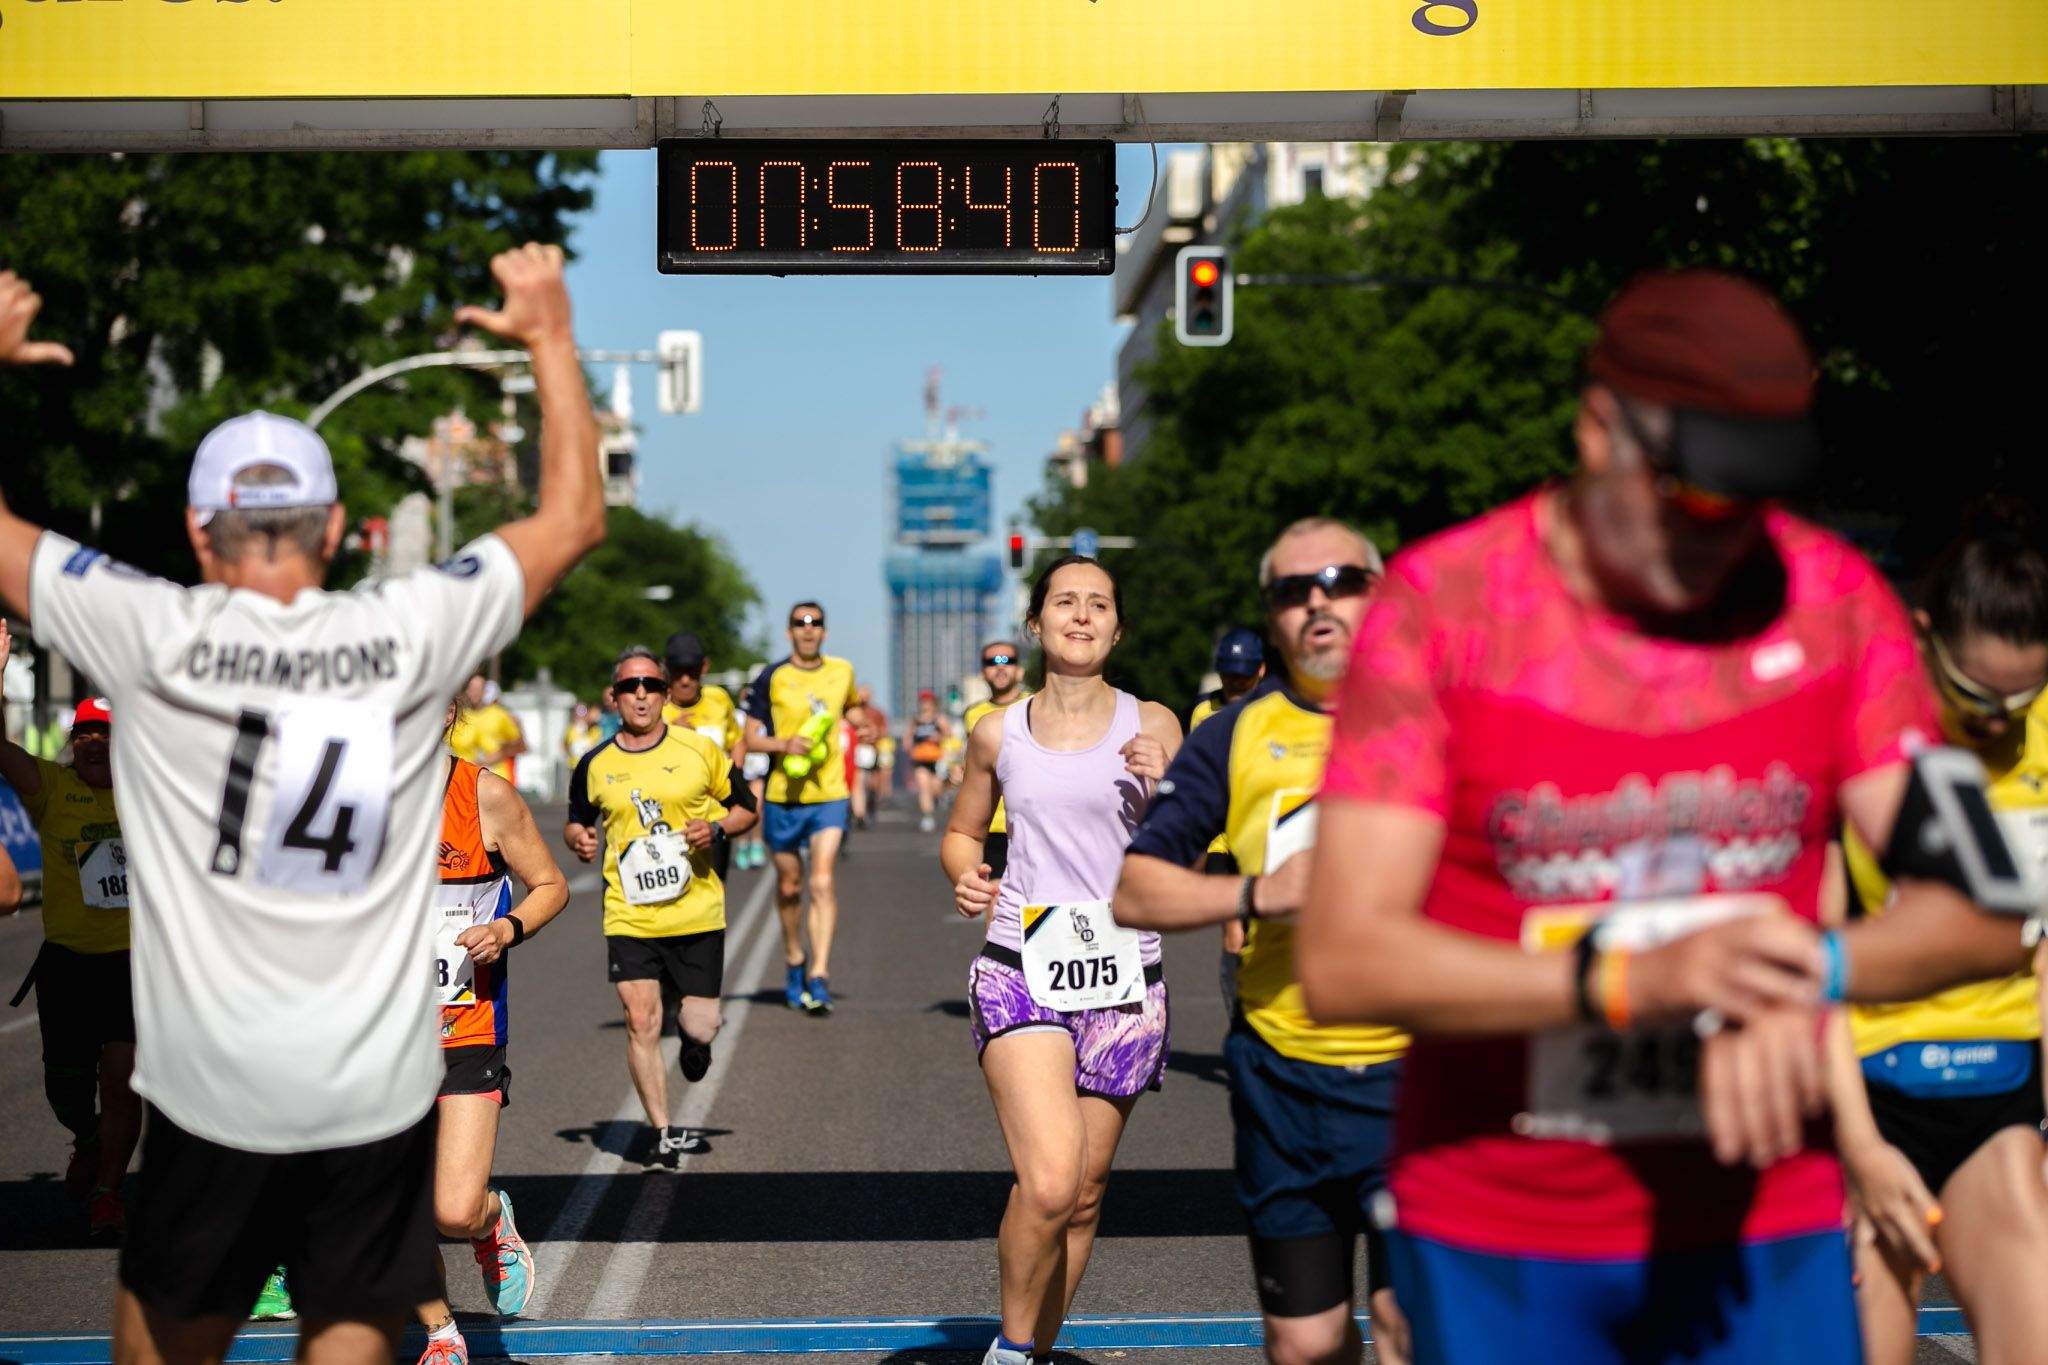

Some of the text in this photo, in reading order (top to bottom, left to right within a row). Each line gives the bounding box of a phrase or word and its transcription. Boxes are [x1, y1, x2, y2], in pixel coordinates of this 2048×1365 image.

[188, 637, 398, 690] CHAMPIONS
[211, 709, 357, 875] 14
[634, 865, 680, 891] 1689
[1048, 954, 1118, 992] 2075
